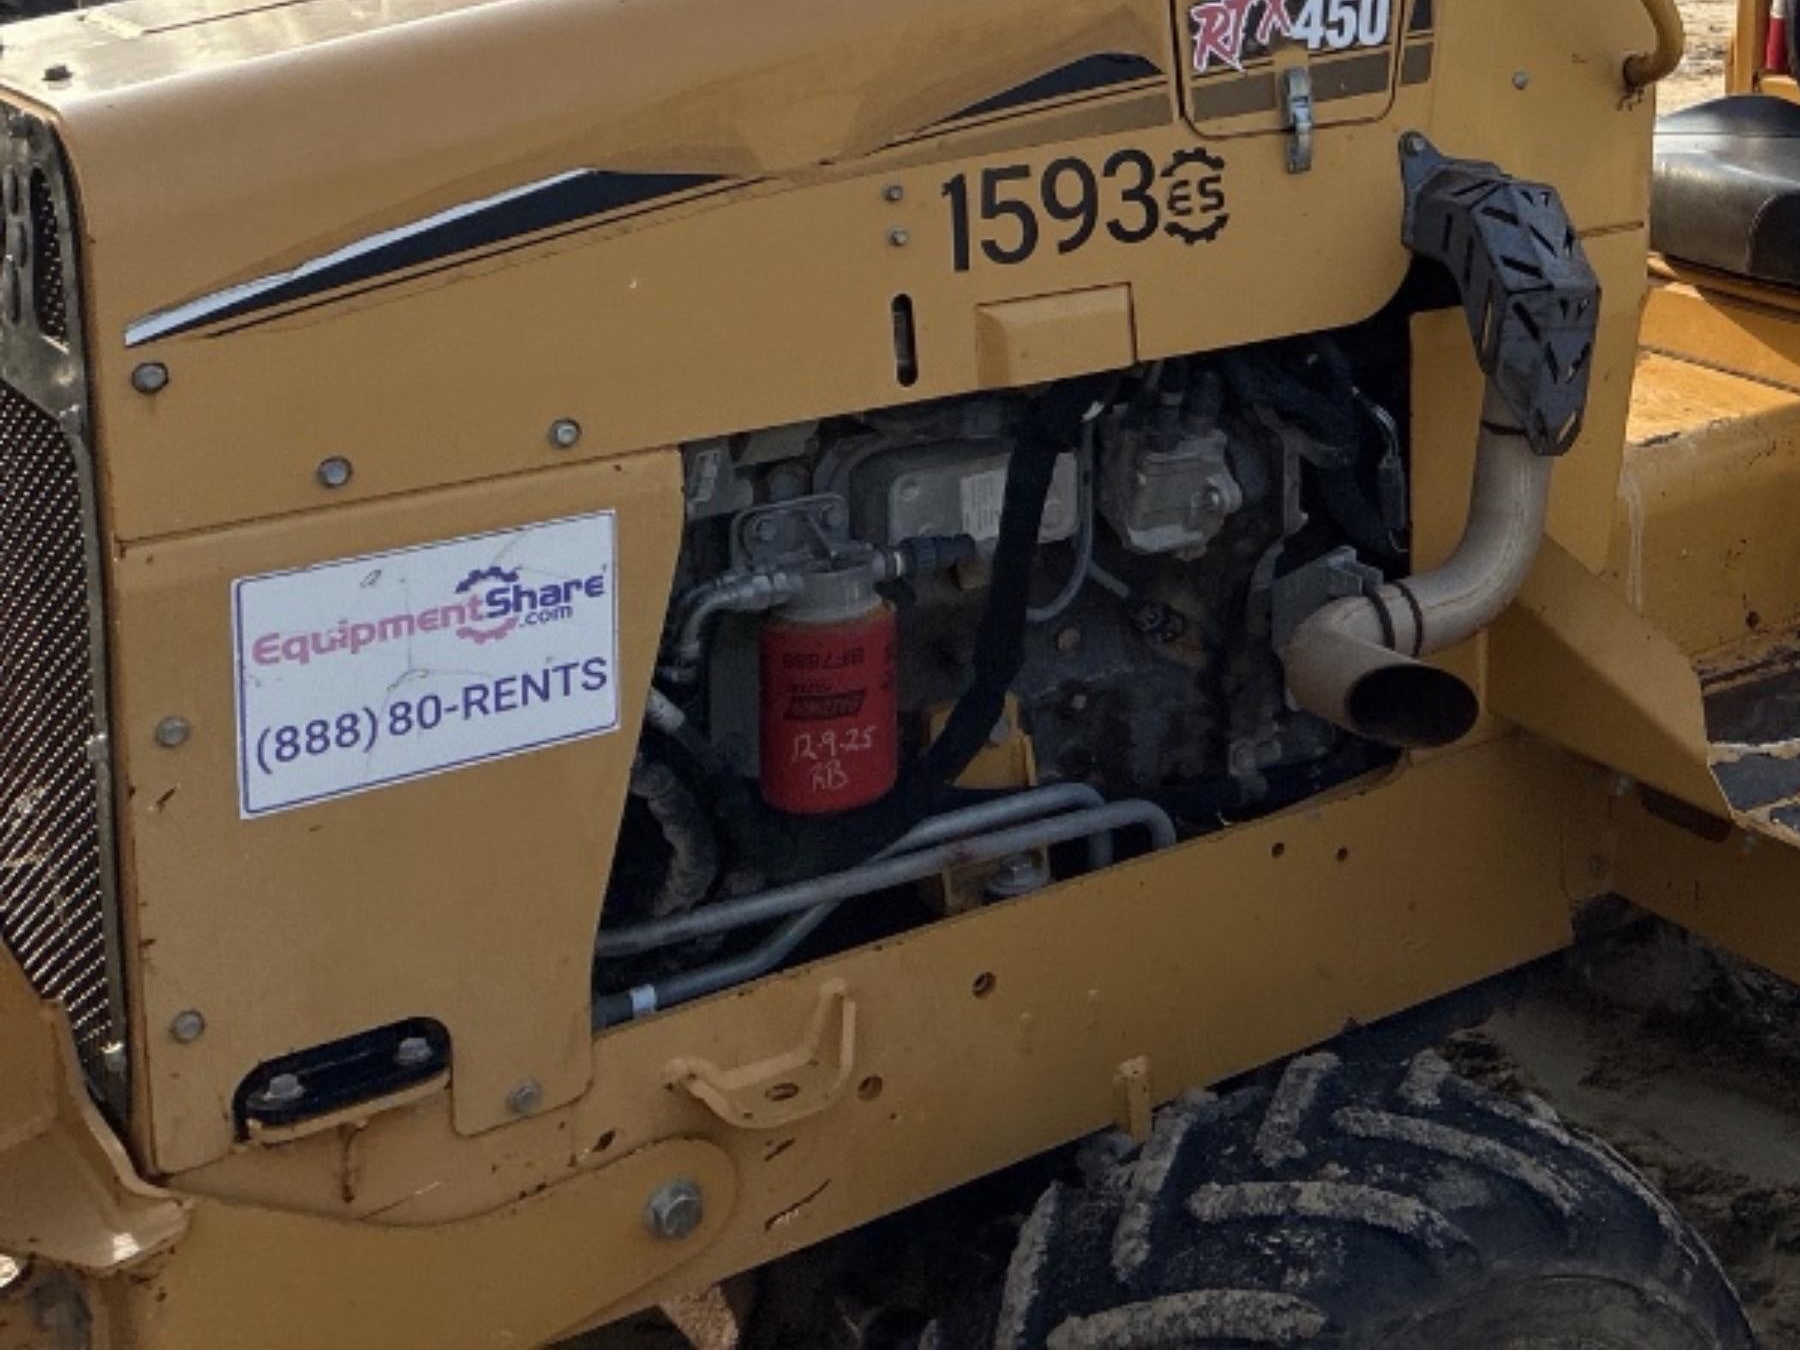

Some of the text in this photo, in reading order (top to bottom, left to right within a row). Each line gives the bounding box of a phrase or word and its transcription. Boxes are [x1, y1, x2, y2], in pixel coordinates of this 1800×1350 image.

[941, 149, 1160, 273] 1593
[251, 574, 606, 667] EquipmentShare
[518, 603, 575, 630] .com
